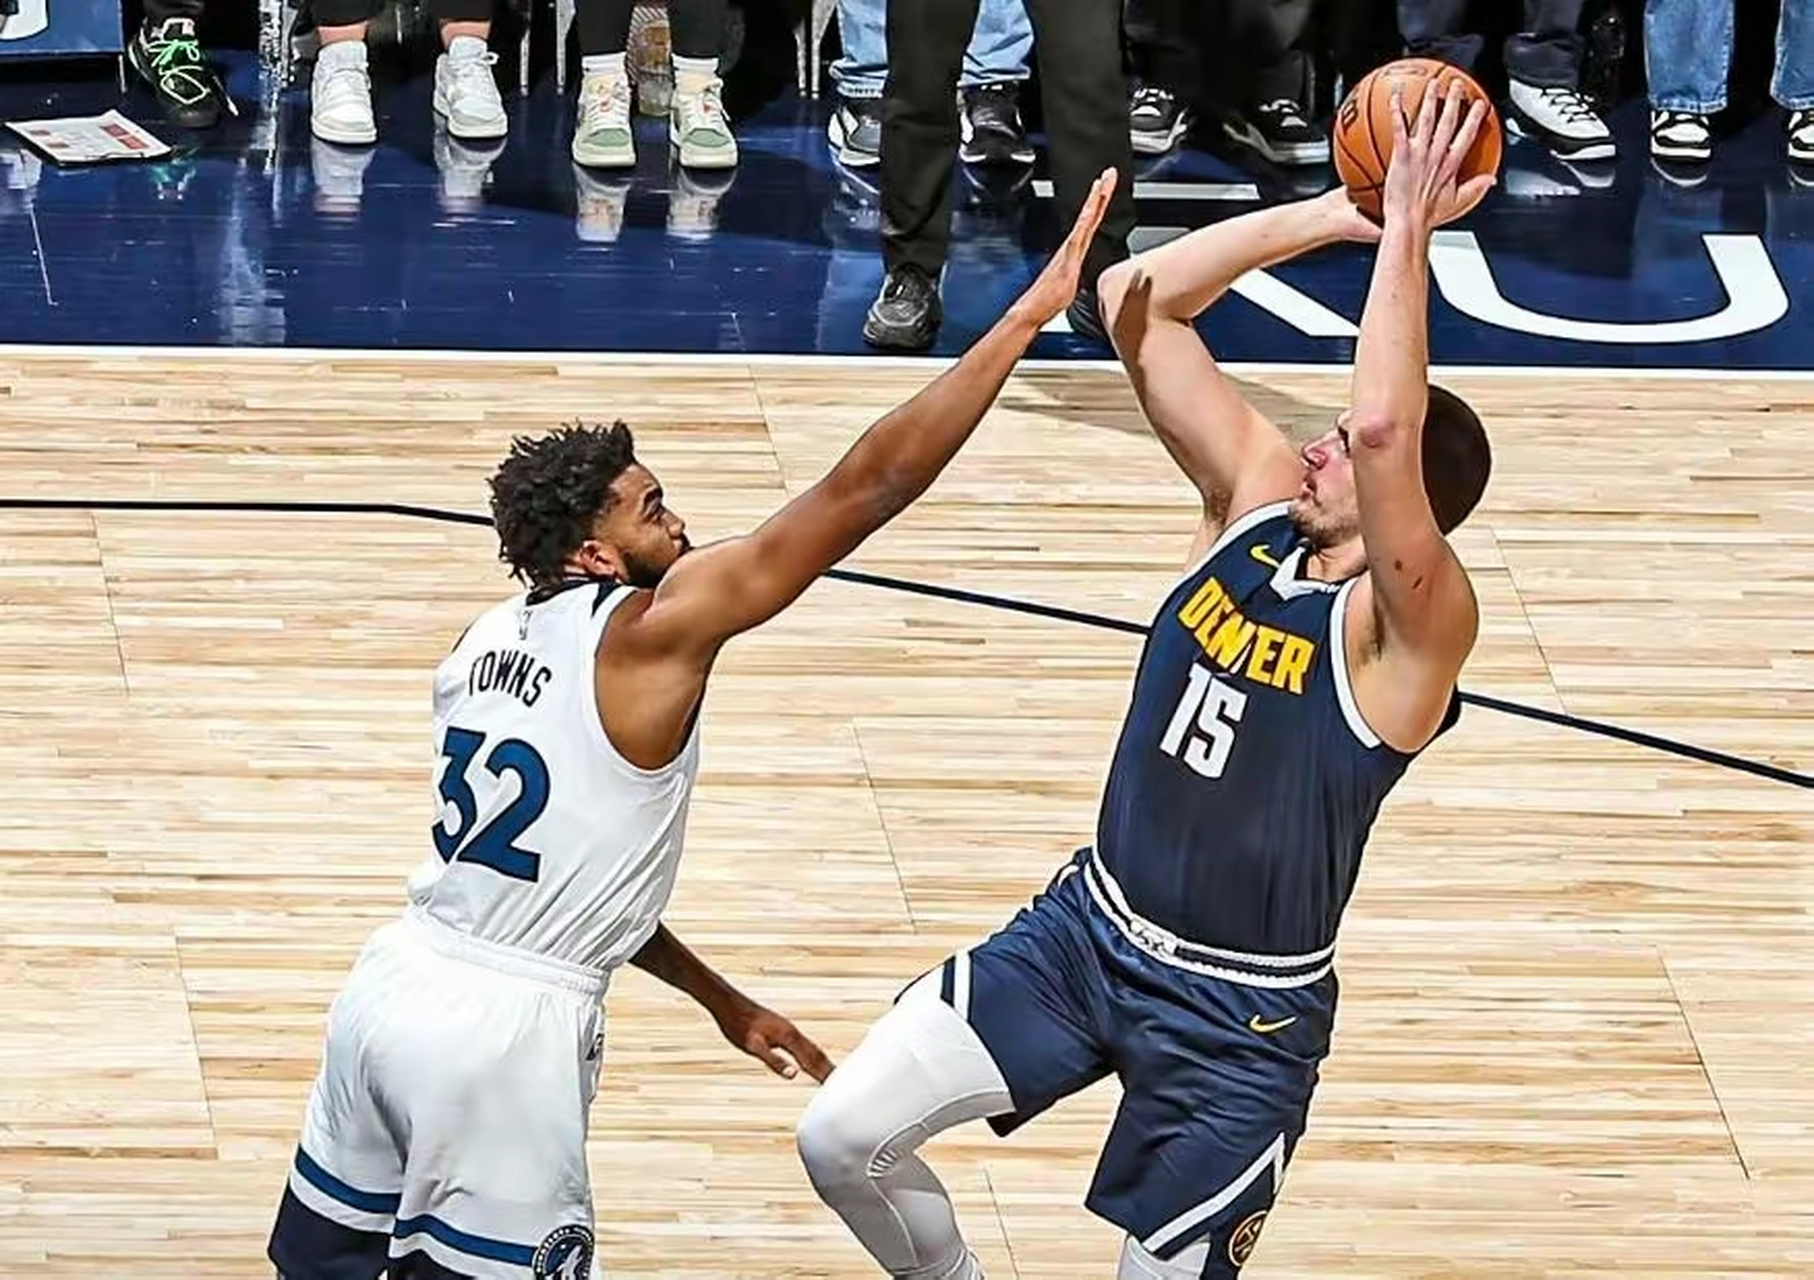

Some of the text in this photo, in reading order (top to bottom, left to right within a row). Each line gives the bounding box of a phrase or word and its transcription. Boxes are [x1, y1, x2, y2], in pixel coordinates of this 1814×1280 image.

[469, 649, 552, 708] TOWNS
[1177, 576, 1317, 695] DENVER
[1159, 661, 1248, 779] 15
[431, 725, 551, 883] 32
